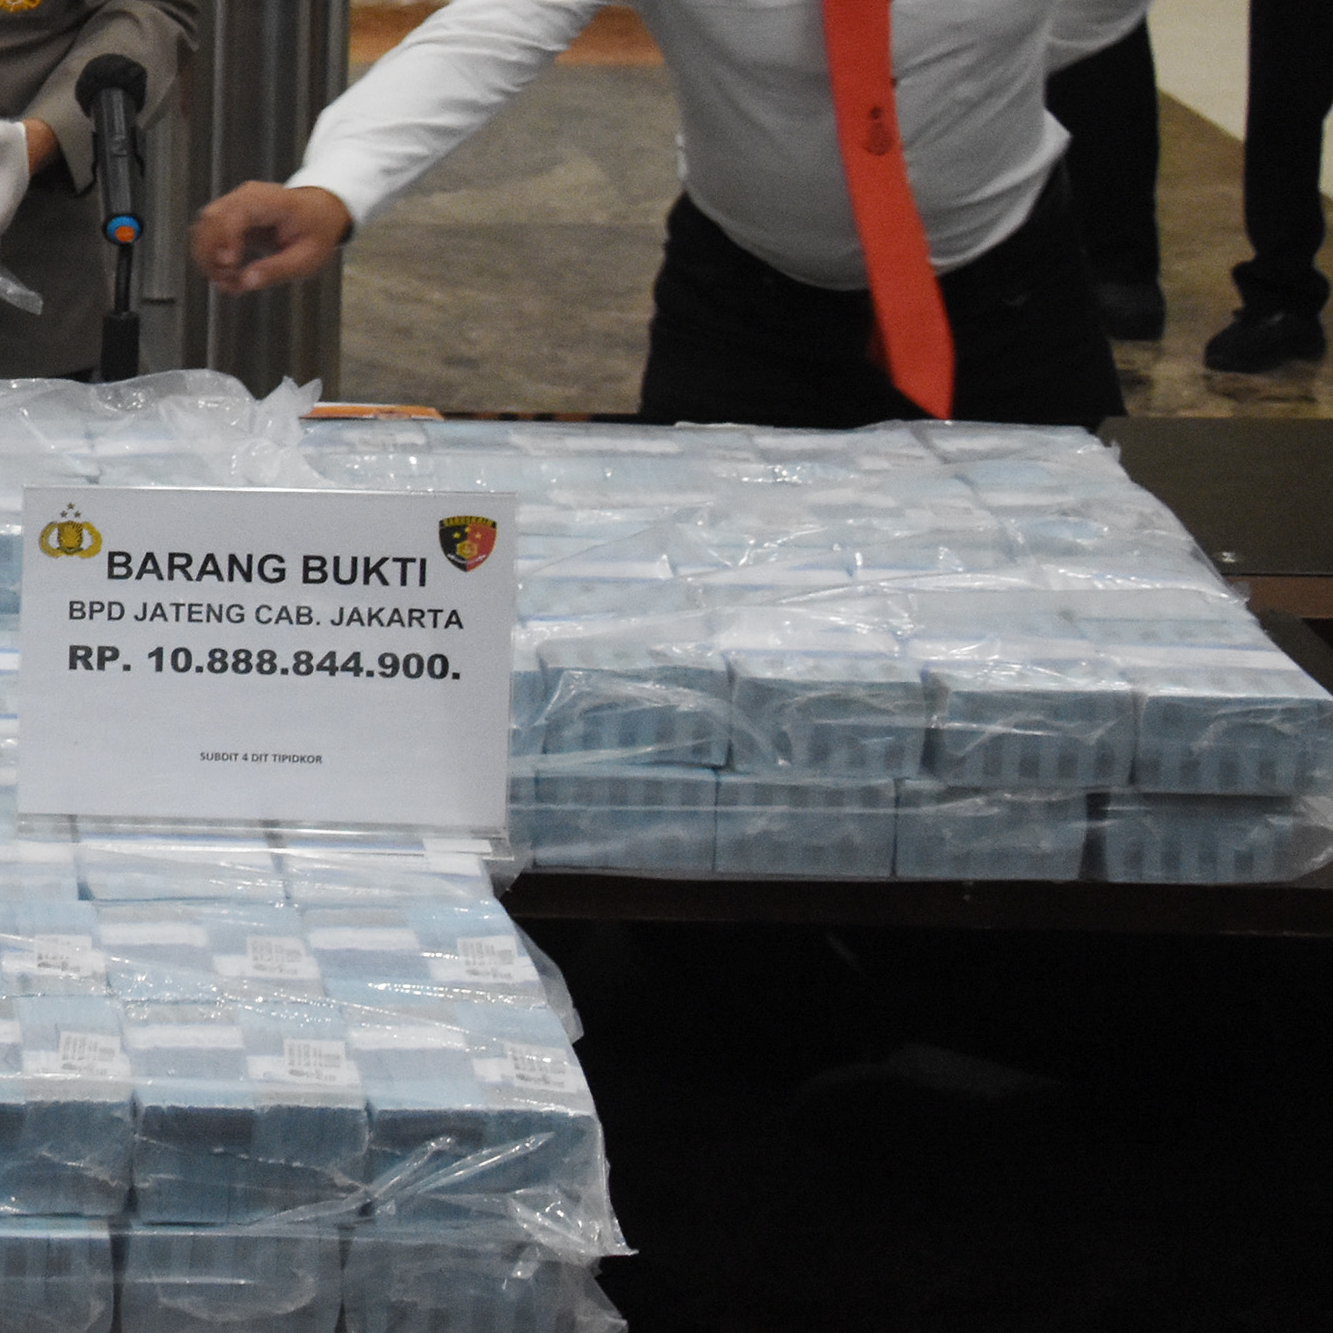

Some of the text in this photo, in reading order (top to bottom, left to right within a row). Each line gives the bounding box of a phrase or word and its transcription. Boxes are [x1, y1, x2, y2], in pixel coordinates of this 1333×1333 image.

[106, 549, 428, 589] BARANG BUKTI
[68, 599, 465, 631] BPD JATENG CAB. JAKARTA
[67, 643, 462, 682] RP. 10.888.844.900.
[200, 752, 323, 764] SUBDIT 4 DIT TIPIDKOR
